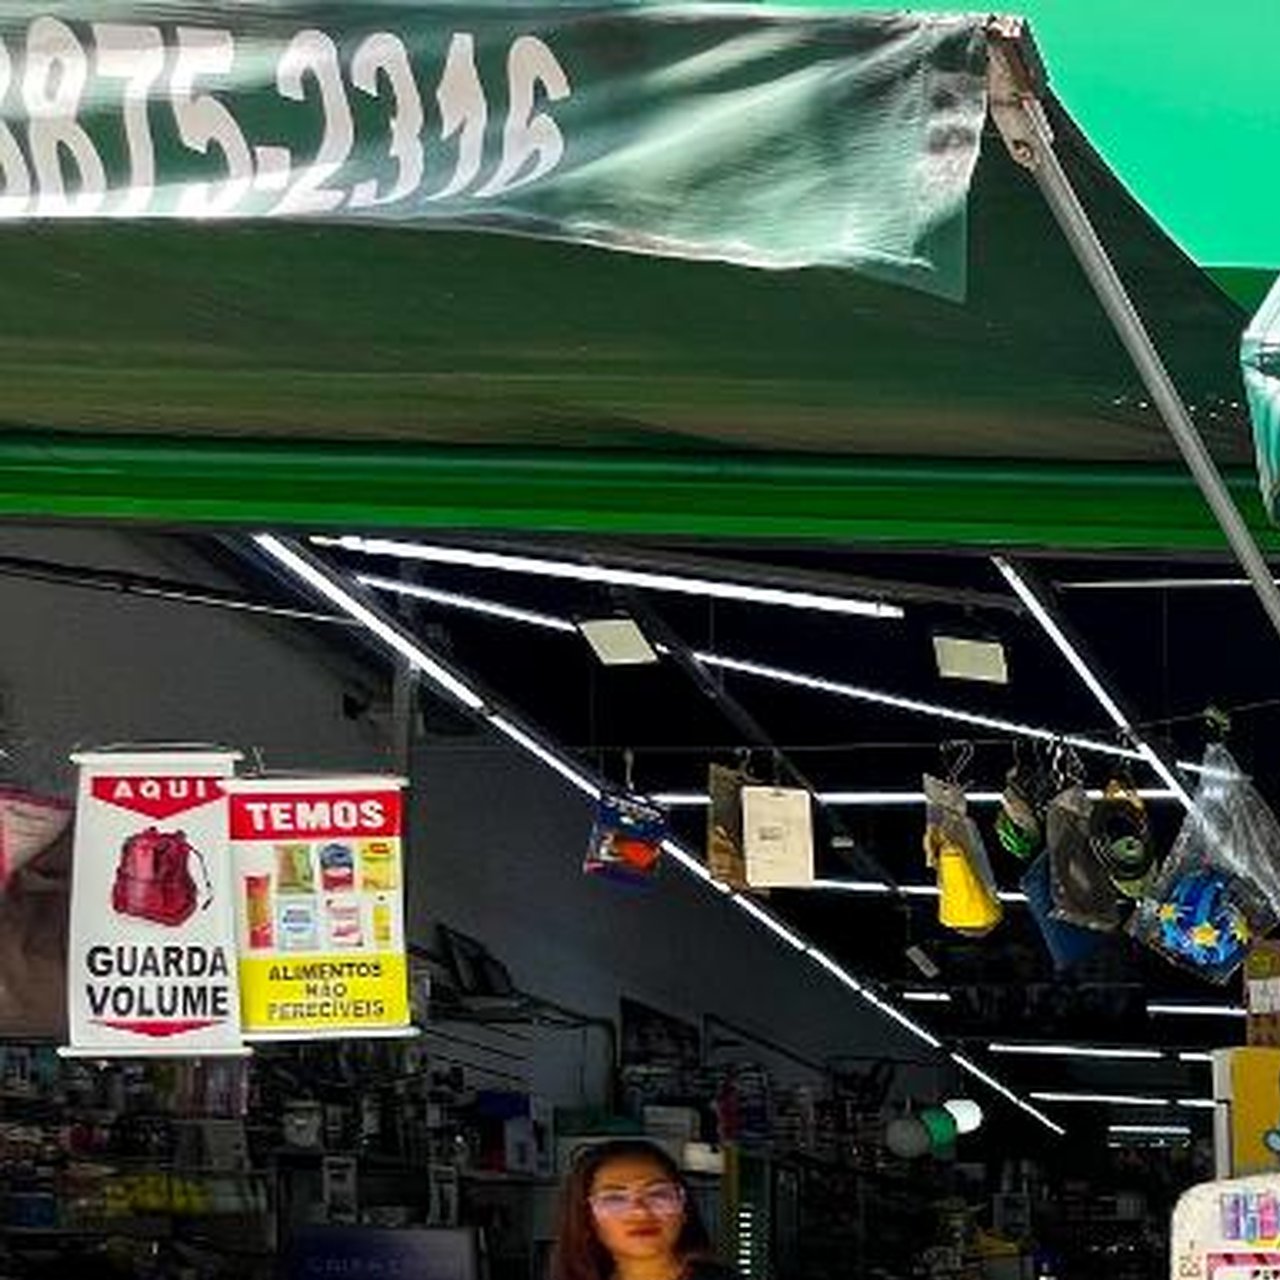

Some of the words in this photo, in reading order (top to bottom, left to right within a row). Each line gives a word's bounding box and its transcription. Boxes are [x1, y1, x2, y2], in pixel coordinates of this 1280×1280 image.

[114, 779, 206, 798] AQUI
[245, 801, 385, 831] TEMOS
[87, 947, 228, 977] GUARDA
[268, 963, 381, 981] ALIMENTOS
[86, 985, 229, 1016] VOLUME
